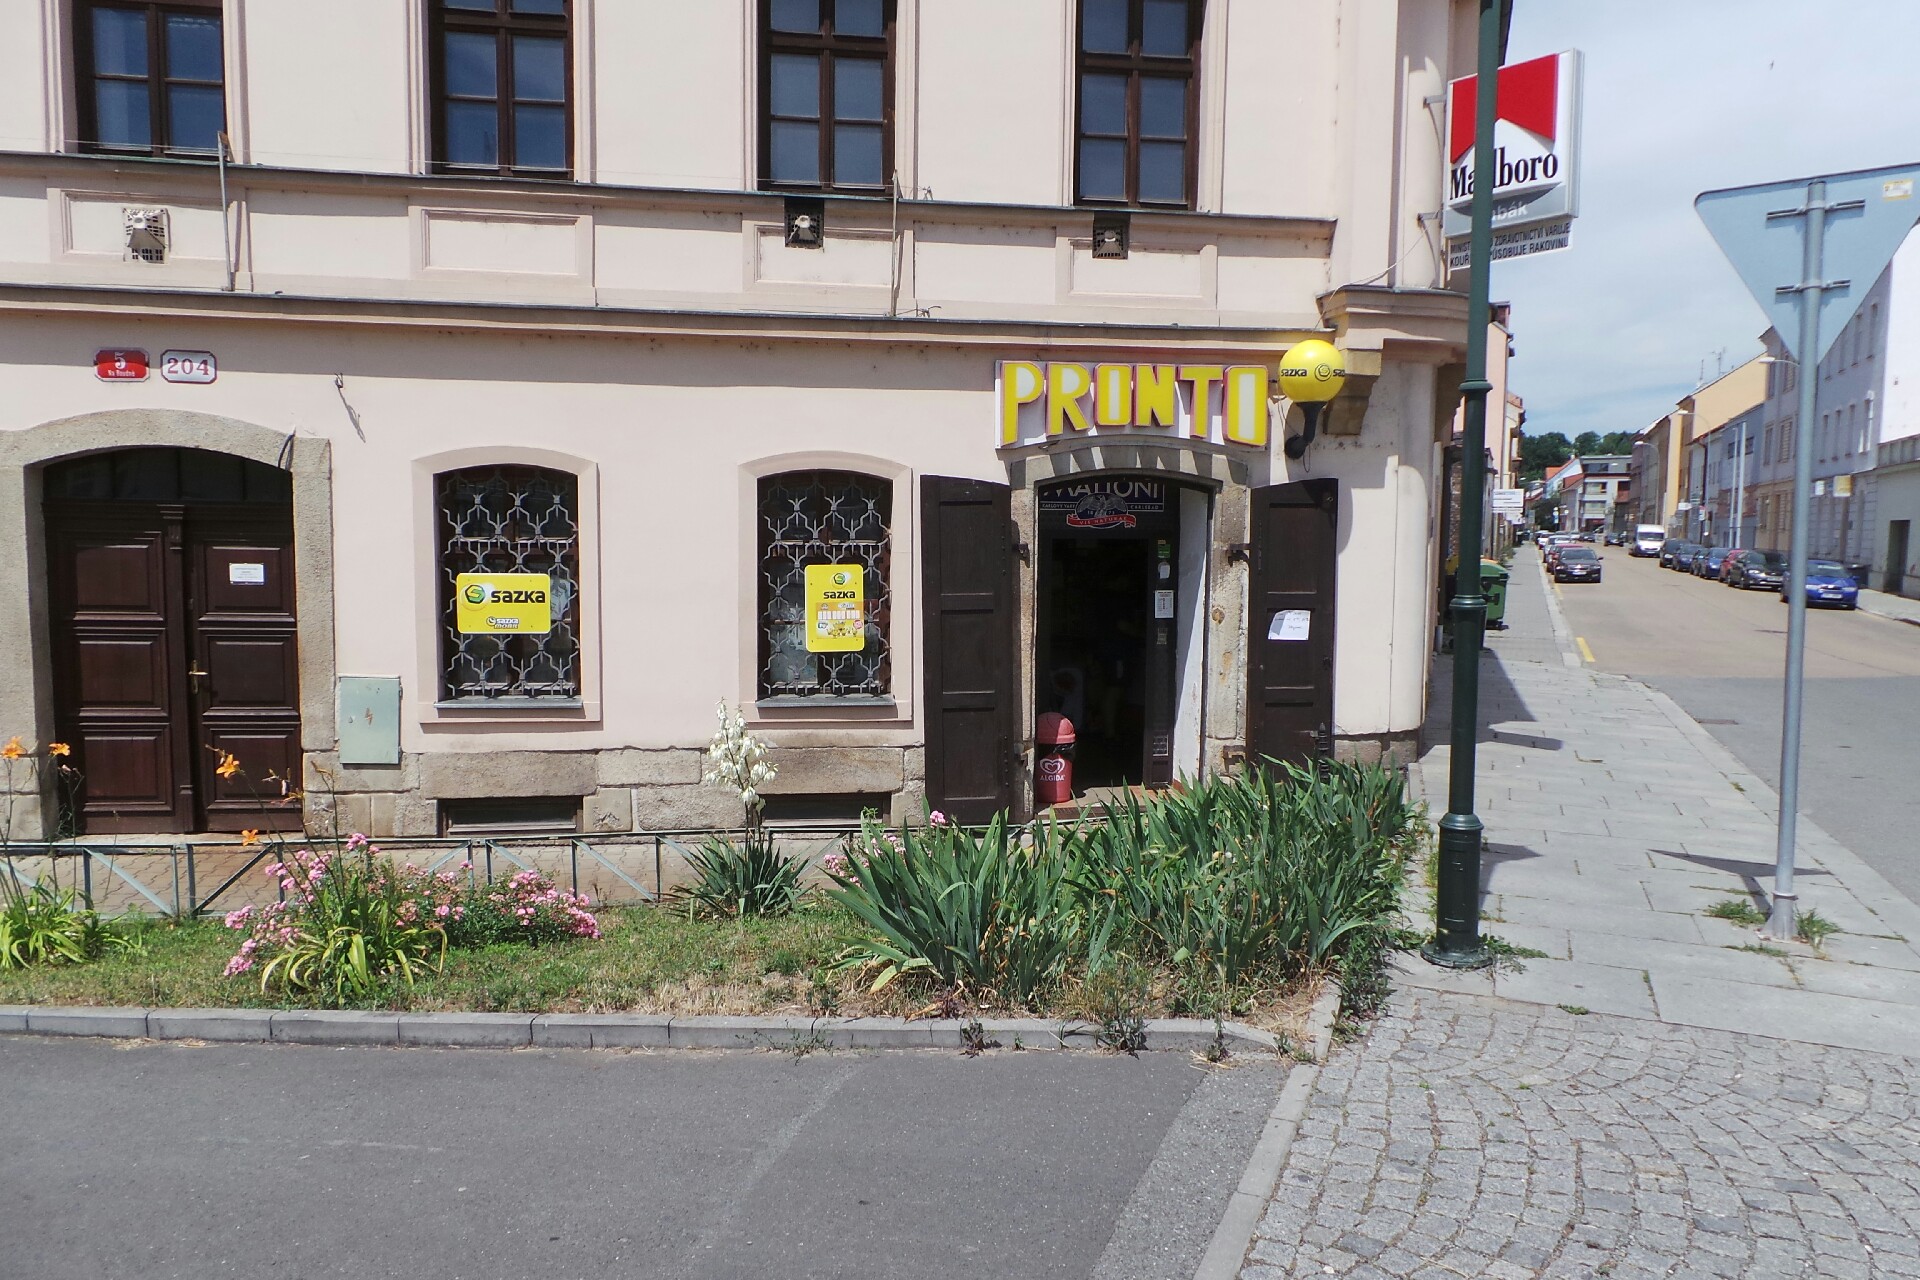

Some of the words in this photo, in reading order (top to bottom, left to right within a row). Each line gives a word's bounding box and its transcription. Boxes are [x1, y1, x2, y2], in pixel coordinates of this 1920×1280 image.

[1450, 146, 1558, 200] Malboro
[1529, 236, 1569, 253] RAKOVINU
[114, 352, 126, 369] 5
[168, 358, 209, 375] 204
[1281, 368, 1308, 377] sazka
[1001, 360, 1269, 447] PRONTO
[491, 591, 545, 603] sazka
[823, 590, 856, 599] sazka
[1040, 774, 1065, 782] ALGIDA
